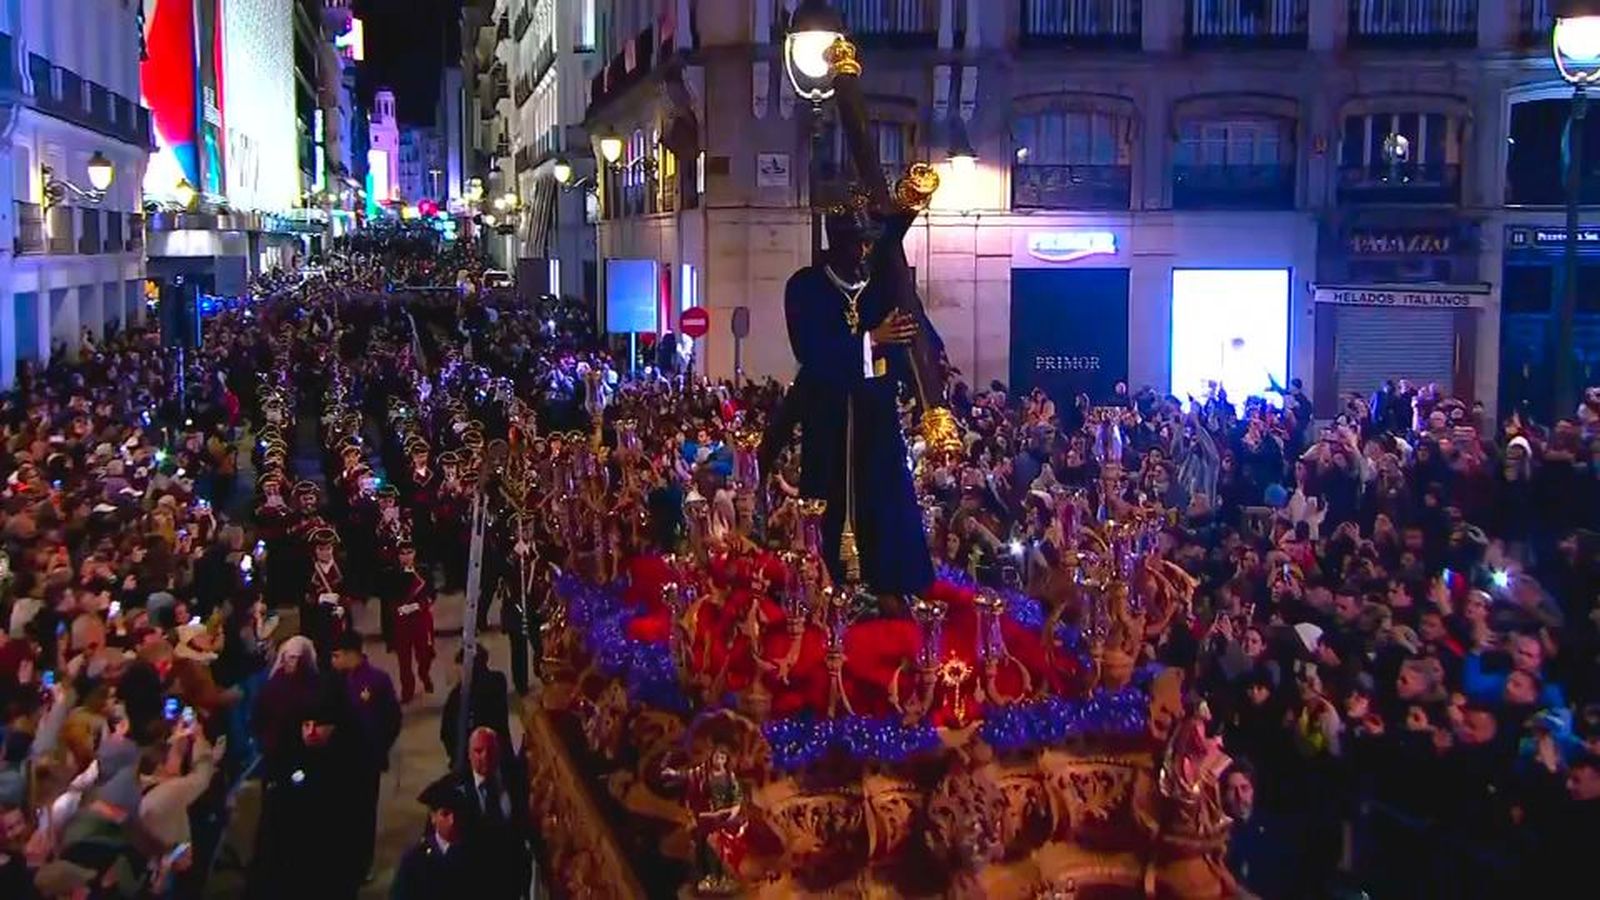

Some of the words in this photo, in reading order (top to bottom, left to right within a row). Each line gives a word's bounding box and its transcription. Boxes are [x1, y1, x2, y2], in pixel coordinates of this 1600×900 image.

[1350, 235, 1451, 253] PALAZZO
[1334, 292, 1397, 305] HELADOS
[1403, 293, 1471, 306] ITALIANOS
[1036, 356, 1101, 370] PRIMOR
